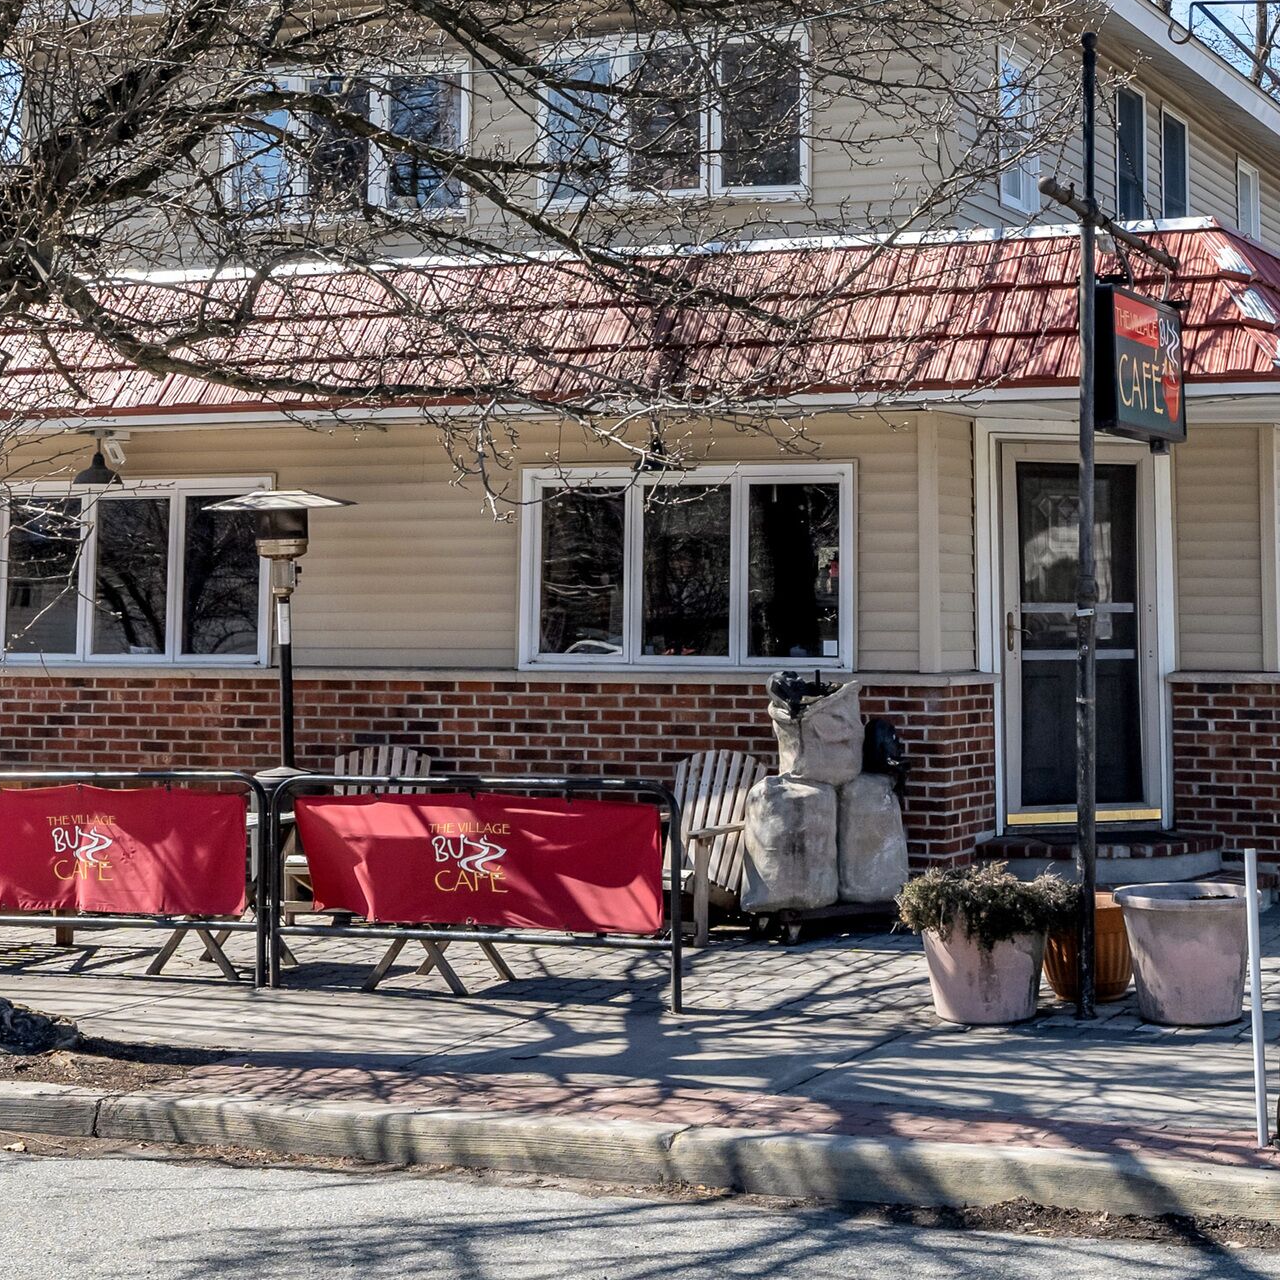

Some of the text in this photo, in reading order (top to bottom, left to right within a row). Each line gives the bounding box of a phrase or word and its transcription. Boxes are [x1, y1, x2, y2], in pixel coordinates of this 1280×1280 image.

[1115, 306, 1130, 330] THE
[1130, 312, 1158, 340] VILLAGE
[1119, 349, 1163, 414] CAFÉ
[46, 814, 116, 826] THE VILLAGE
[429, 822, 511, 835] THE VILLAGE
[54, 854, 113, 881] CAFÉ
[434, 864, 509, 893] CAFÉ
